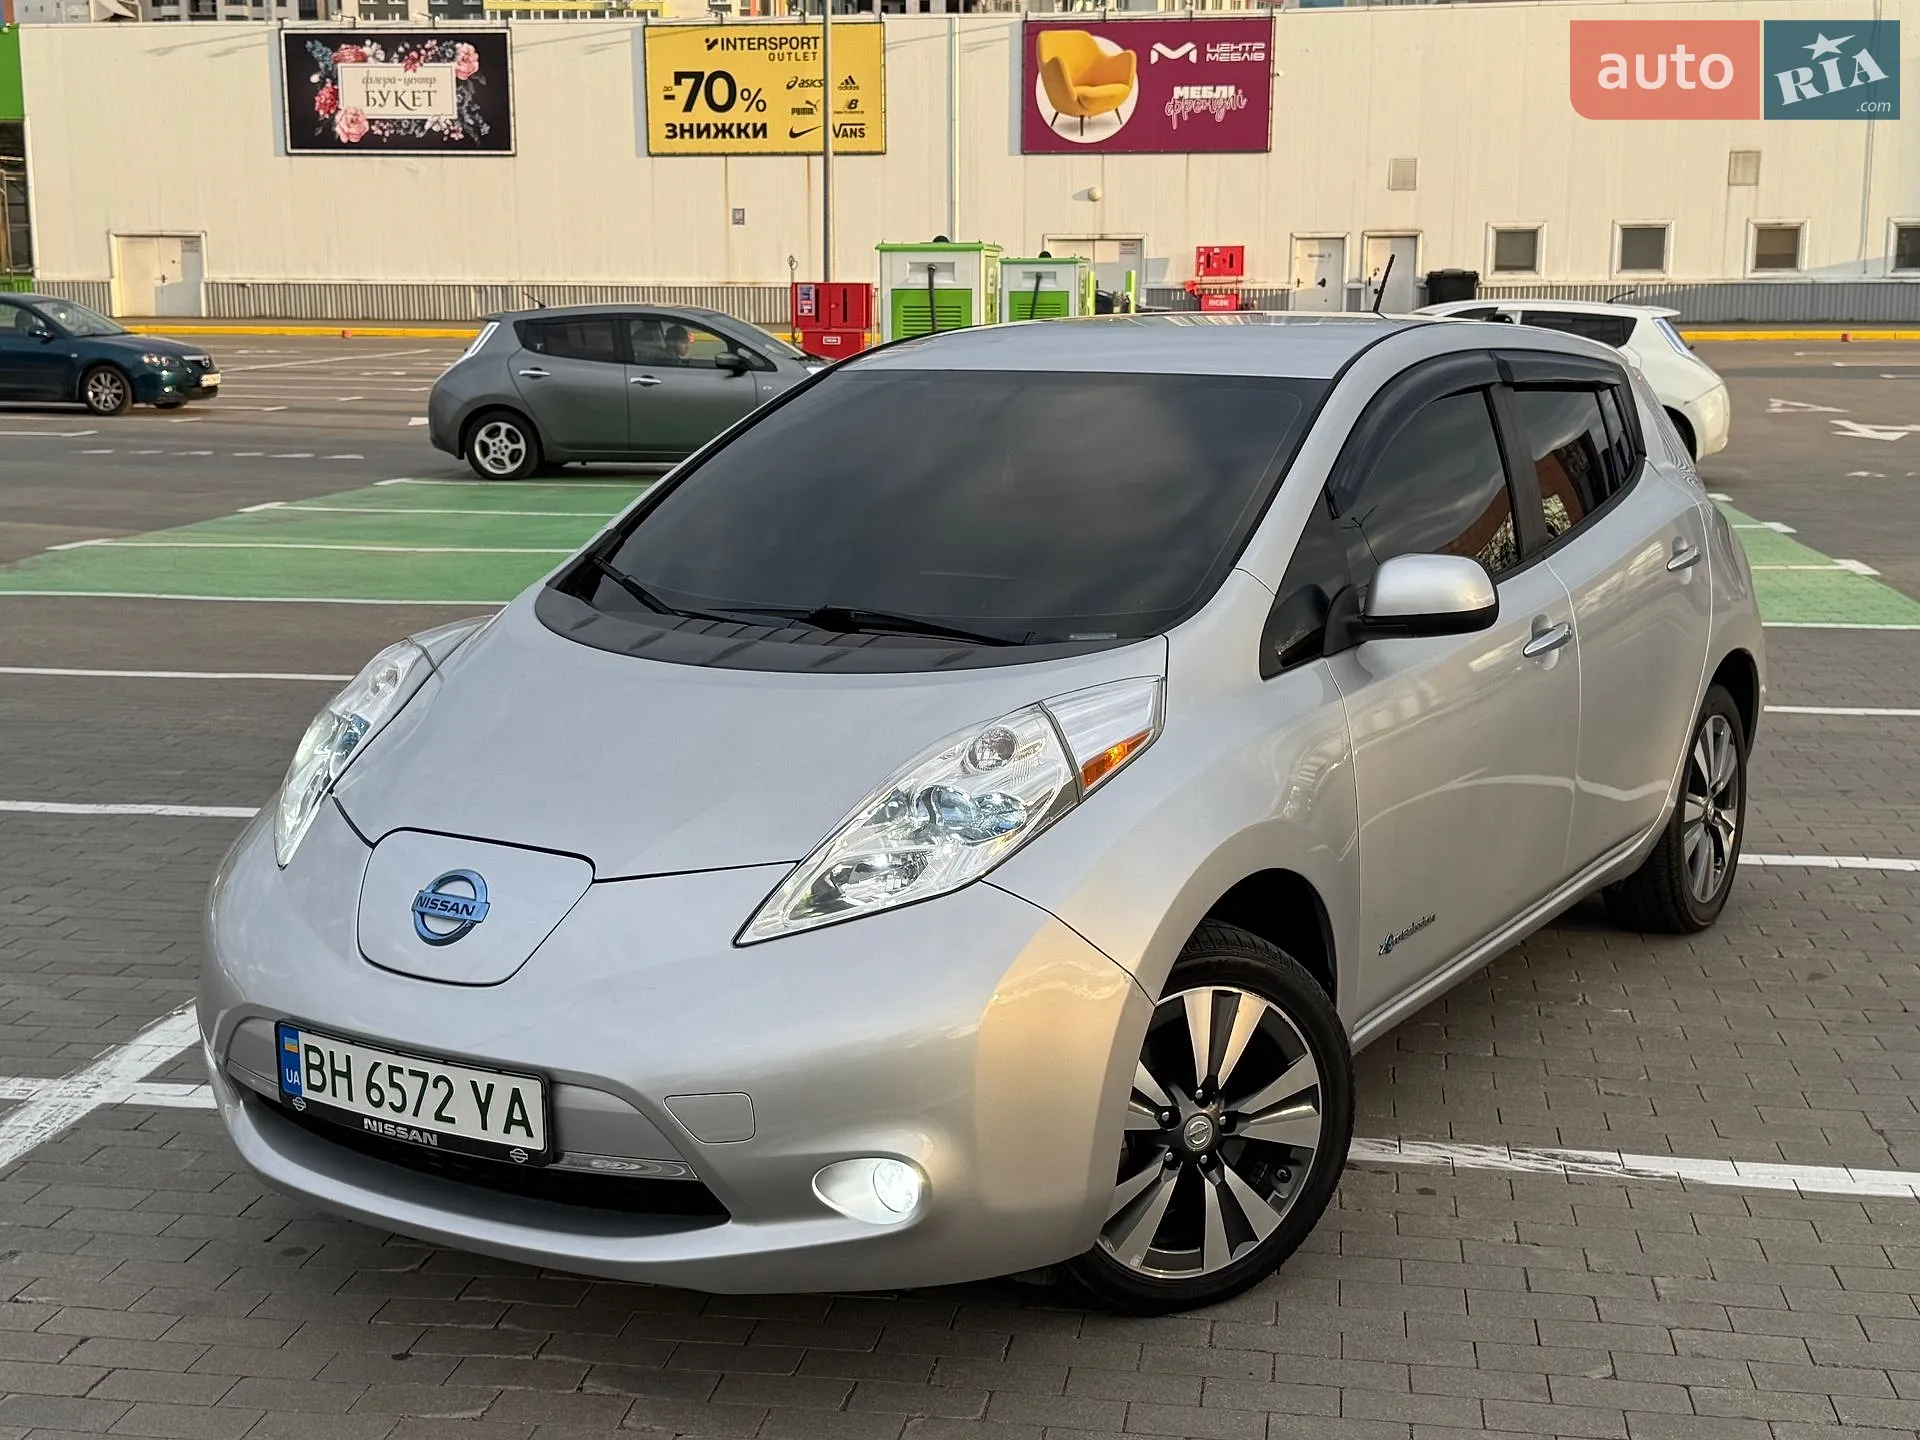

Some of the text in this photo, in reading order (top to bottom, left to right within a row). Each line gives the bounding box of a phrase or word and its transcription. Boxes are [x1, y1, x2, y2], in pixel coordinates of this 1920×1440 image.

[721, 36, 820, 51] INTERSPORT
[1206, 43, 1265, 52] ЦЕНТР
[768, 51, 818, 62] OUTLET
[1206, 53, 1265, 62] МЕБЛІВ
[365, 90, 437, 111] БУКЕТ
[1173, 85, 1236, 99] МЕБЛІ
[416, 895, 476, 916] NISSAN
[286, 1067, 301, 1086] UA
[303, 1043, 534, 1138] BH 6572 YA
[363, 1117, 438, 1147] NISSAN
